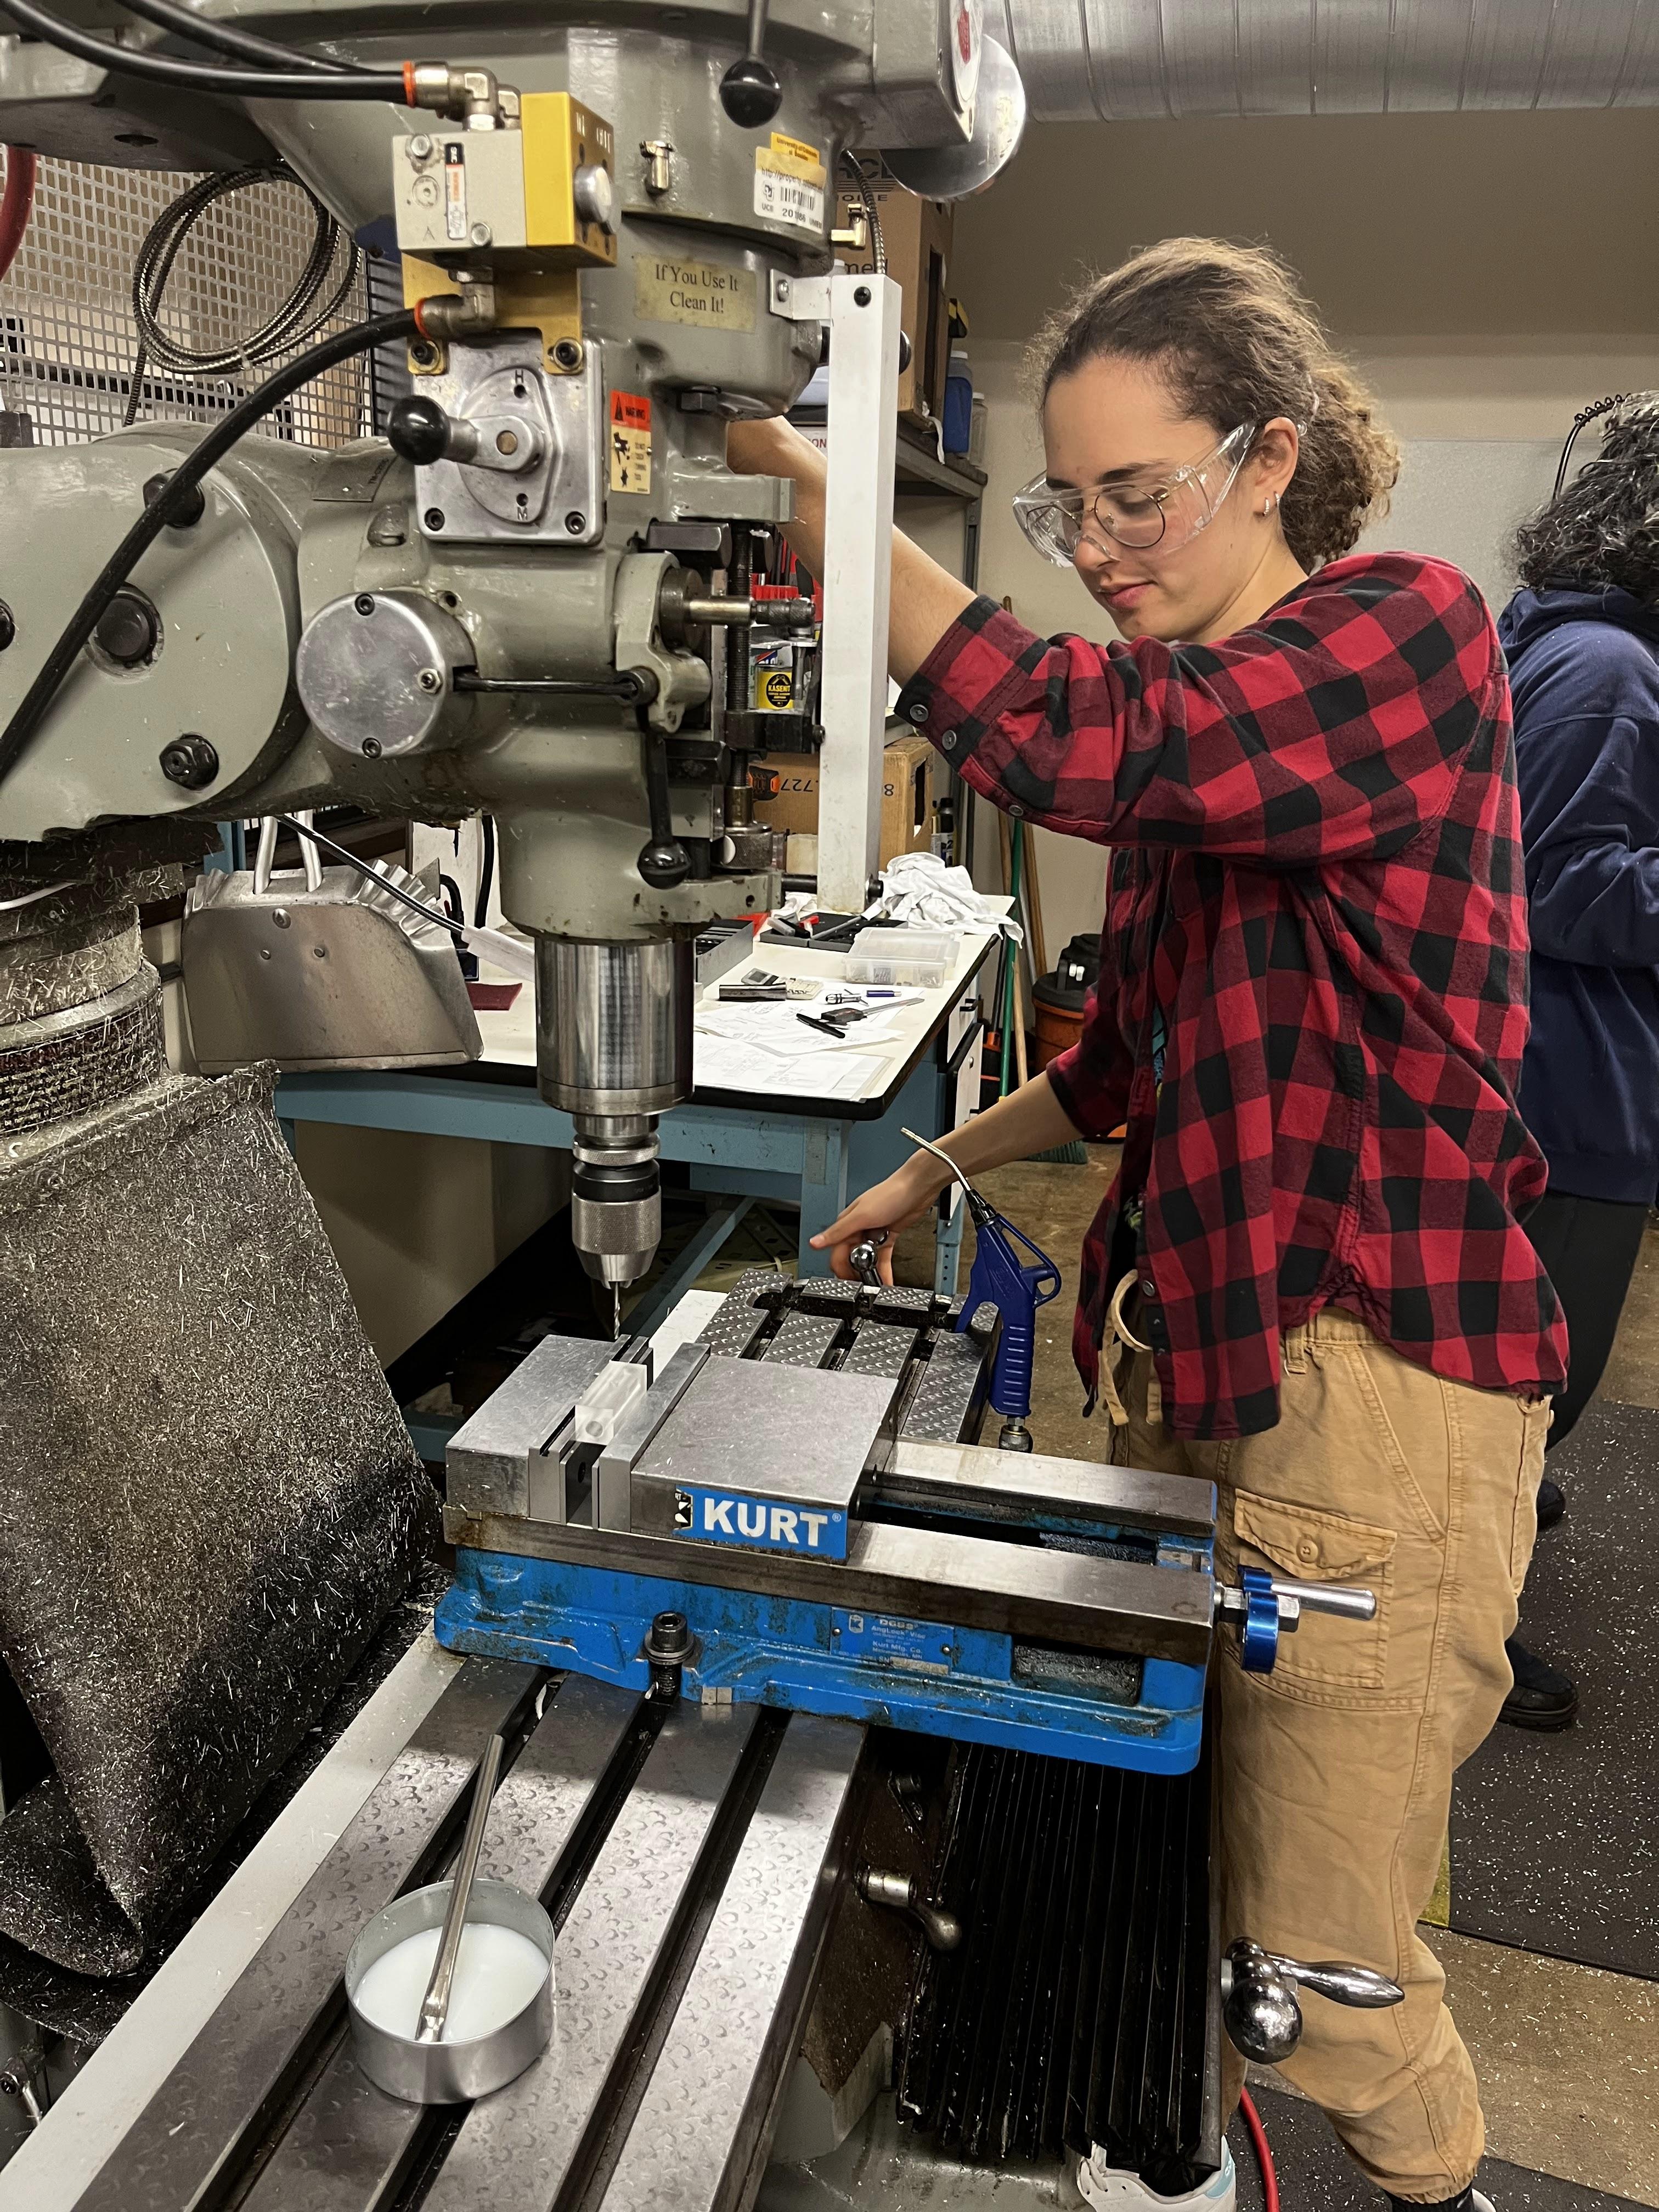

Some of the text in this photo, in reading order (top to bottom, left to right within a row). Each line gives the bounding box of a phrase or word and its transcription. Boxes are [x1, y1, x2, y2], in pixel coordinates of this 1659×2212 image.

[656, 264, 739, 291] If You Use It
[670, 291, 724, 313] Clean It!
[515, 369, 524, 384] H
[517, 506, 528, 521] M
[704, 1498, 828, 1547] KURT
[872, 1640, 890, 1649] Kurt
